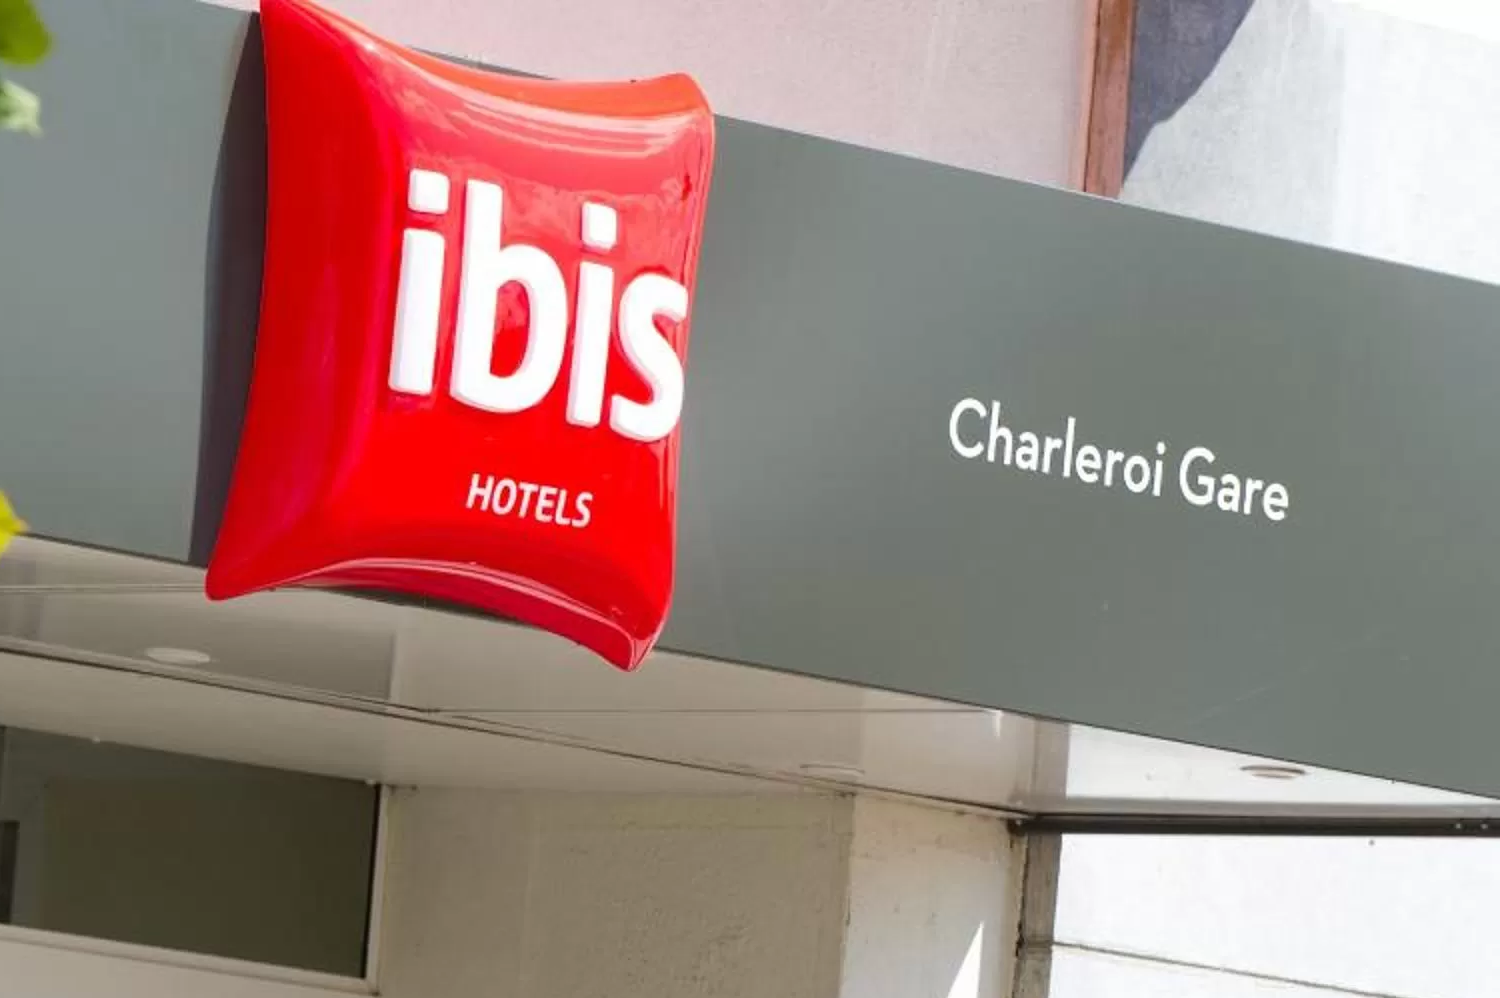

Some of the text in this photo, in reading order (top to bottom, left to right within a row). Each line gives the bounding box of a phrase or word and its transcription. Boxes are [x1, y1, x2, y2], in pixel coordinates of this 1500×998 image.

[388, 168, 689, 443] ibis
[466, 473, 593, 528] HOTELS
[949, 398, 1289, 521] Charleroi Gare
